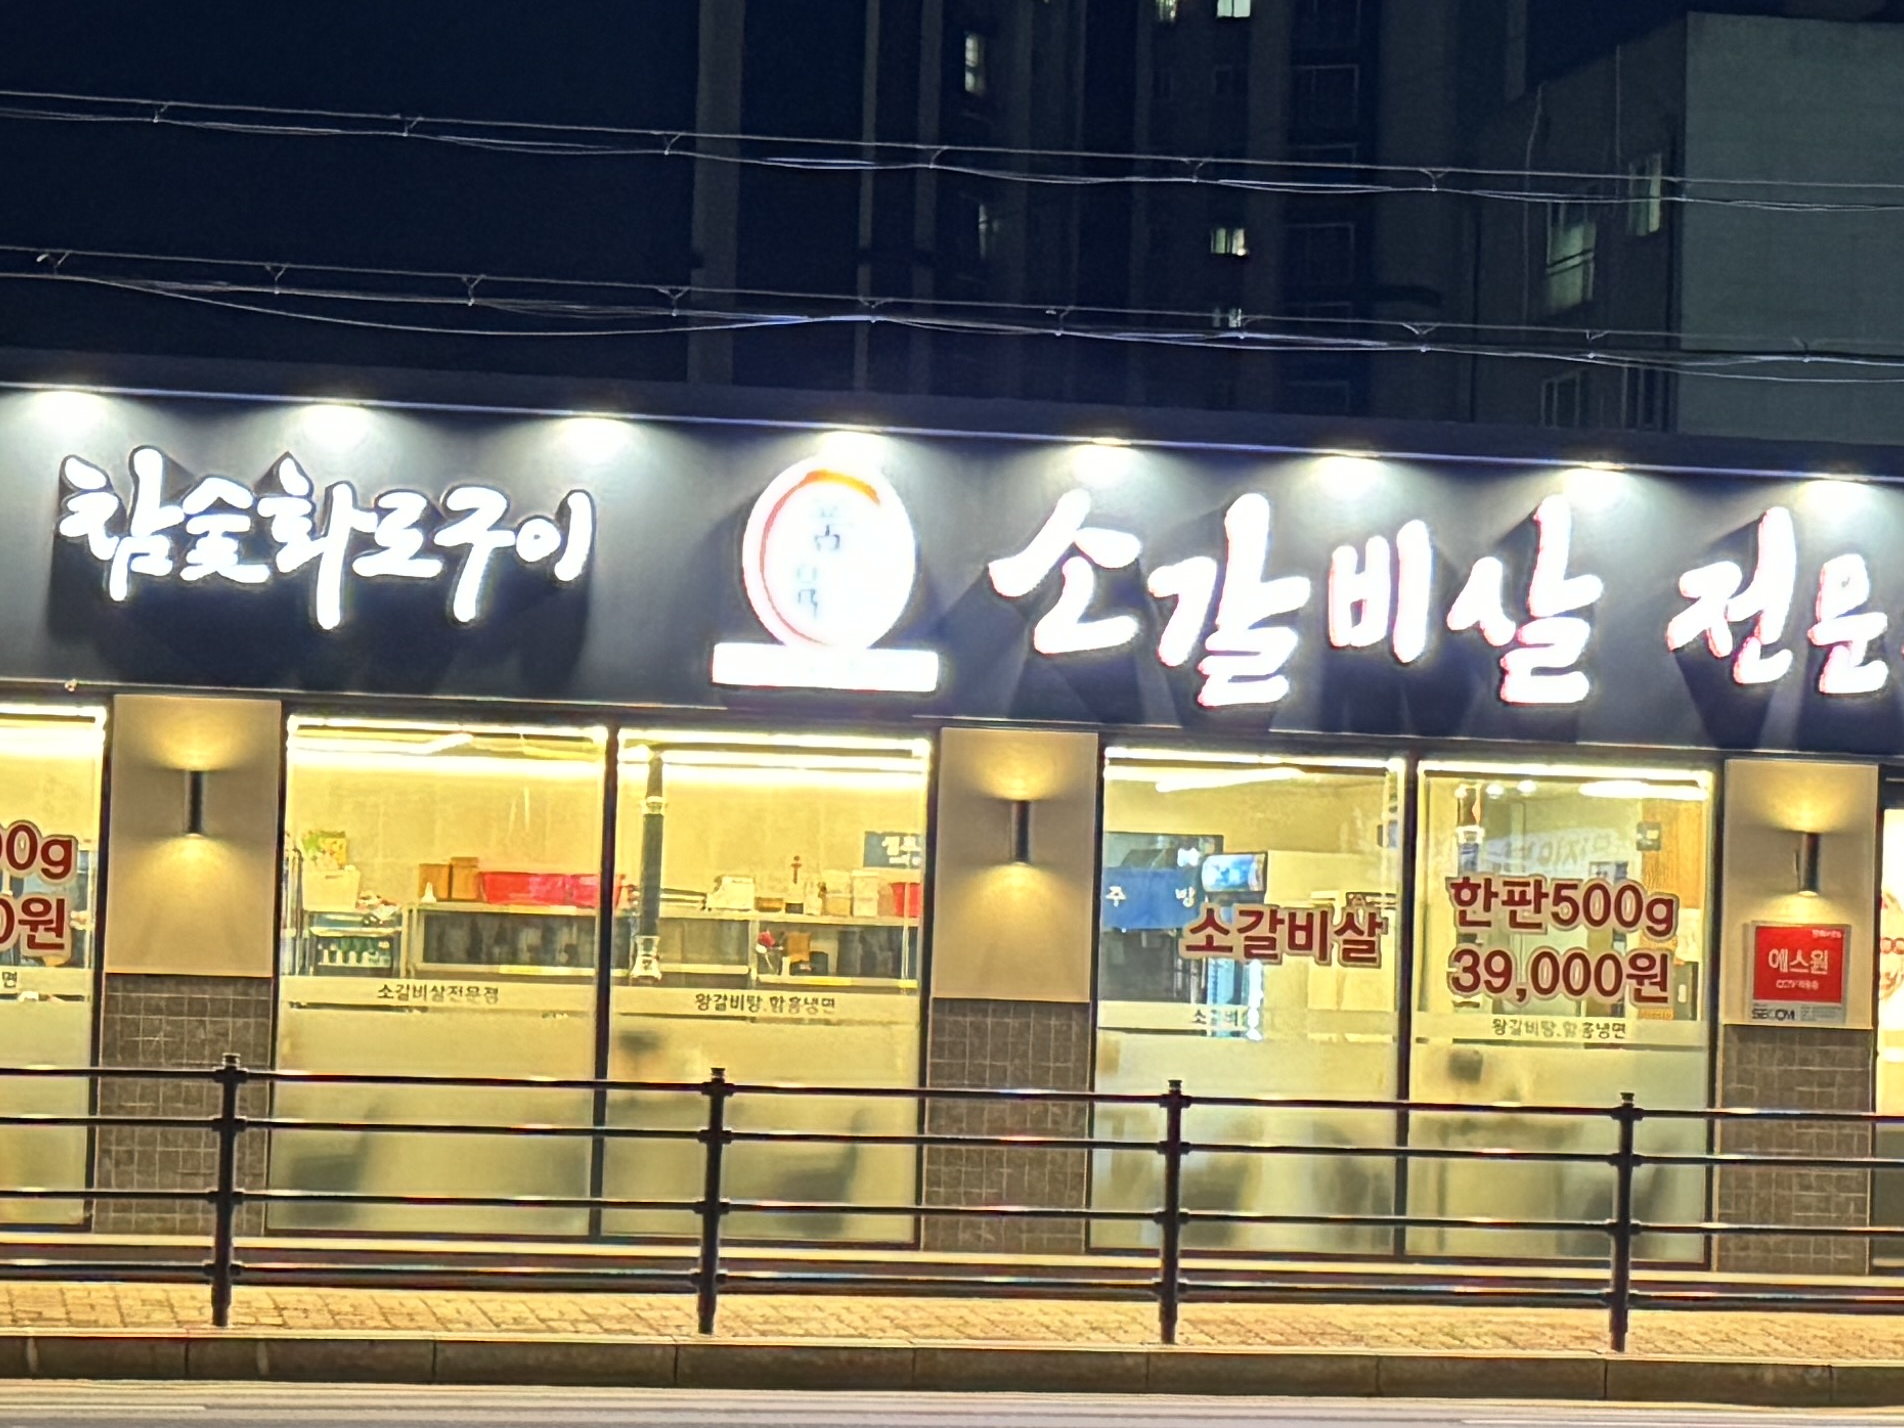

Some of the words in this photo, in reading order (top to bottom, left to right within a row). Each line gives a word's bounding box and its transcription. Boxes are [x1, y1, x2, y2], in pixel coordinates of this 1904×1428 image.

[988, 487, 1605, 708] 소갈비살
[1449, 875, 1676, 938] 한판500g
[1185, 907, 1385, 963] 소갈비살
[1767, 947, 1830, 975] 에스원
[1449, 948, 1670, 1004] 39,000원
